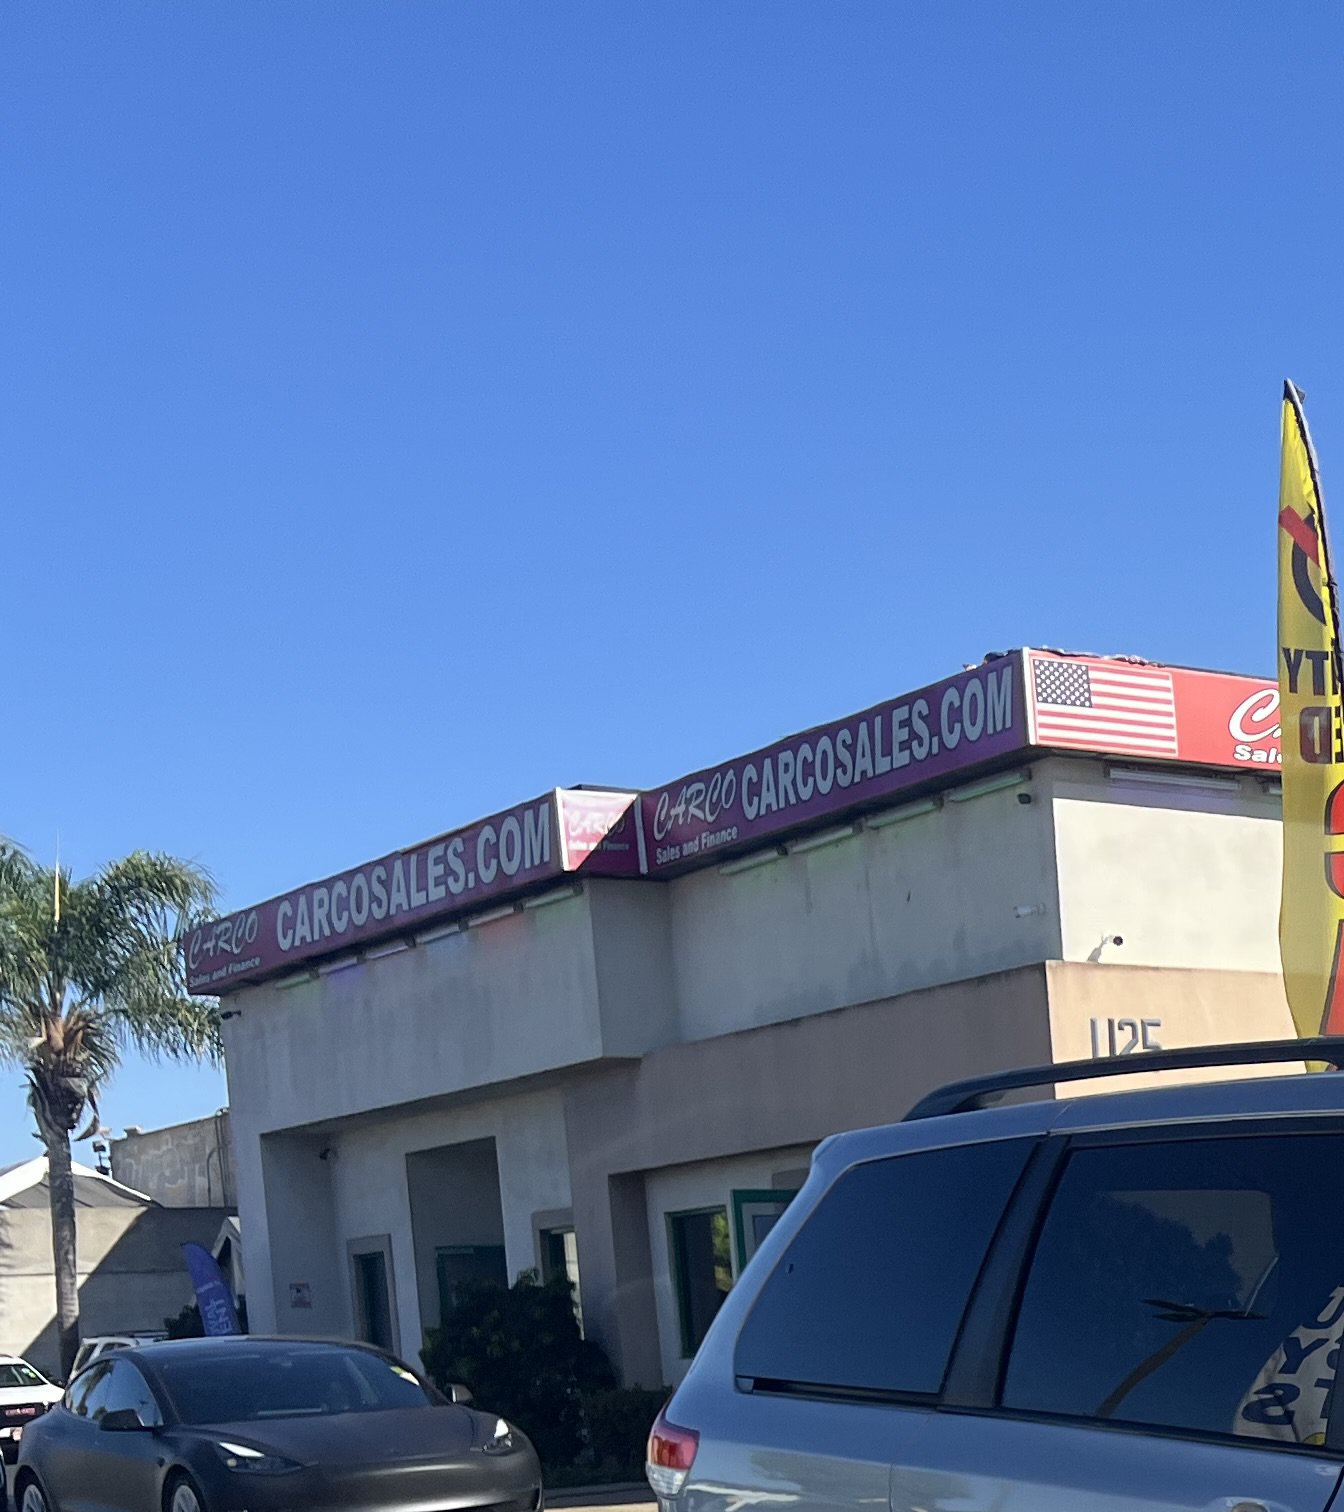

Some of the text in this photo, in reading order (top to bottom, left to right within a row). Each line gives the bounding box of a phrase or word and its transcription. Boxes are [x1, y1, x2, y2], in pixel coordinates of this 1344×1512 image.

[741, 665, 1014, 821] CARCOSALES.COM
[1233, 744, 1283, 764] Sal
[653, 768, 737, 841] CARCO
[276, 802, 550, 952] CARCOSALES.COM
[655, 826, 738, 864] Sales and Finance
[188, 909, 258, 970] CARCO
